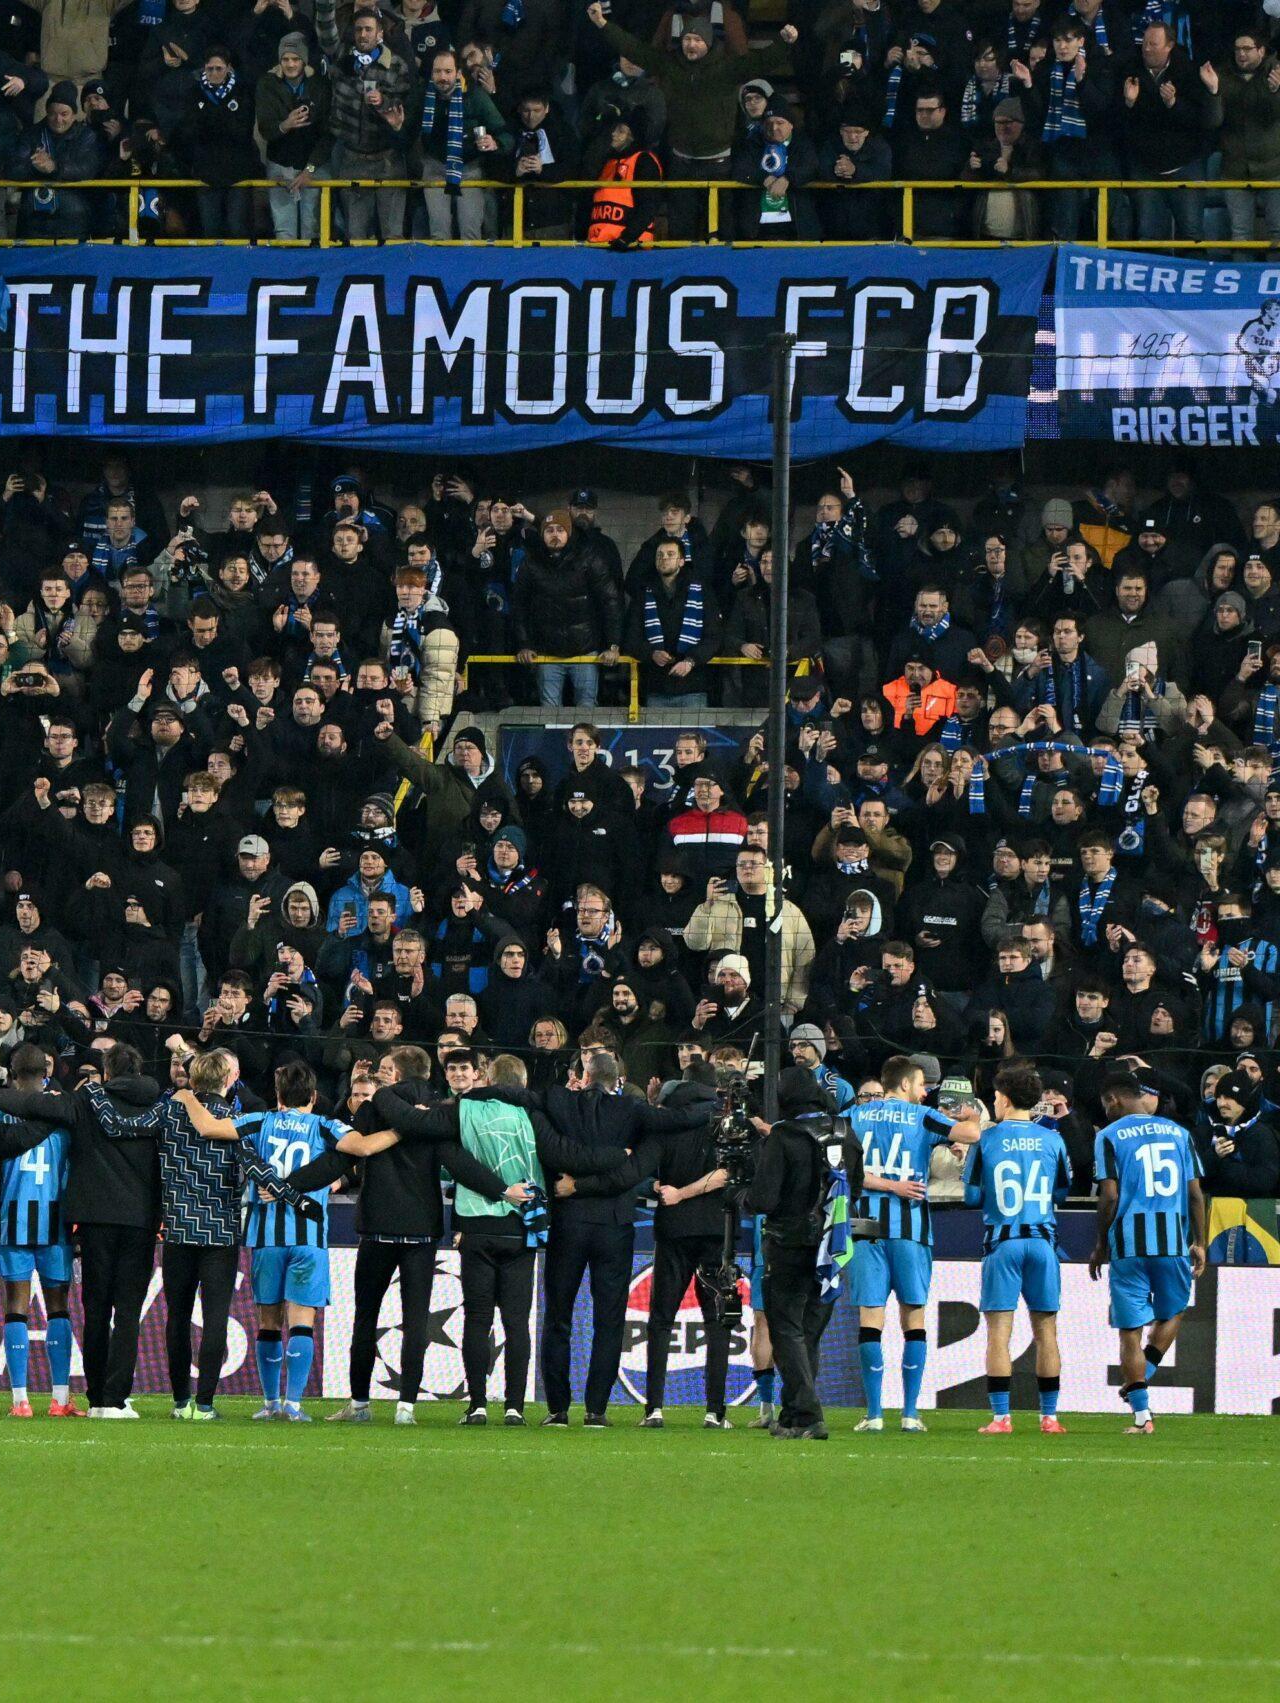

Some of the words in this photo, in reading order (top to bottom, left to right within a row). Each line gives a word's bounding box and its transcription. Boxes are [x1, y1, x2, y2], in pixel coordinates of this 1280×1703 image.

[8, 283, 201, 414] THE
[254, 284, 728, 415] FAMOUS
[786, 285, 991, 413] FCB
[1112, 406, 1261, 446] BIRGER
[1124, 771, 1150, 812] CLUB
[858, 1109, 917, 1125] MECHELE
[1117, 1123, 1183, 1140] ONYEDIKA
[267, 1135, 311, 1179] 30
[863, 1131, 915, 1182] 44
[1002, 1137, 1043, 1152] SABBE
[20, 1146, 50, 1185] 4
[1135, 1142, 1180, 1198] 15
[993, 1159, 1052, 1217] 64
[620, 1320, 754, 1356] PEPS
